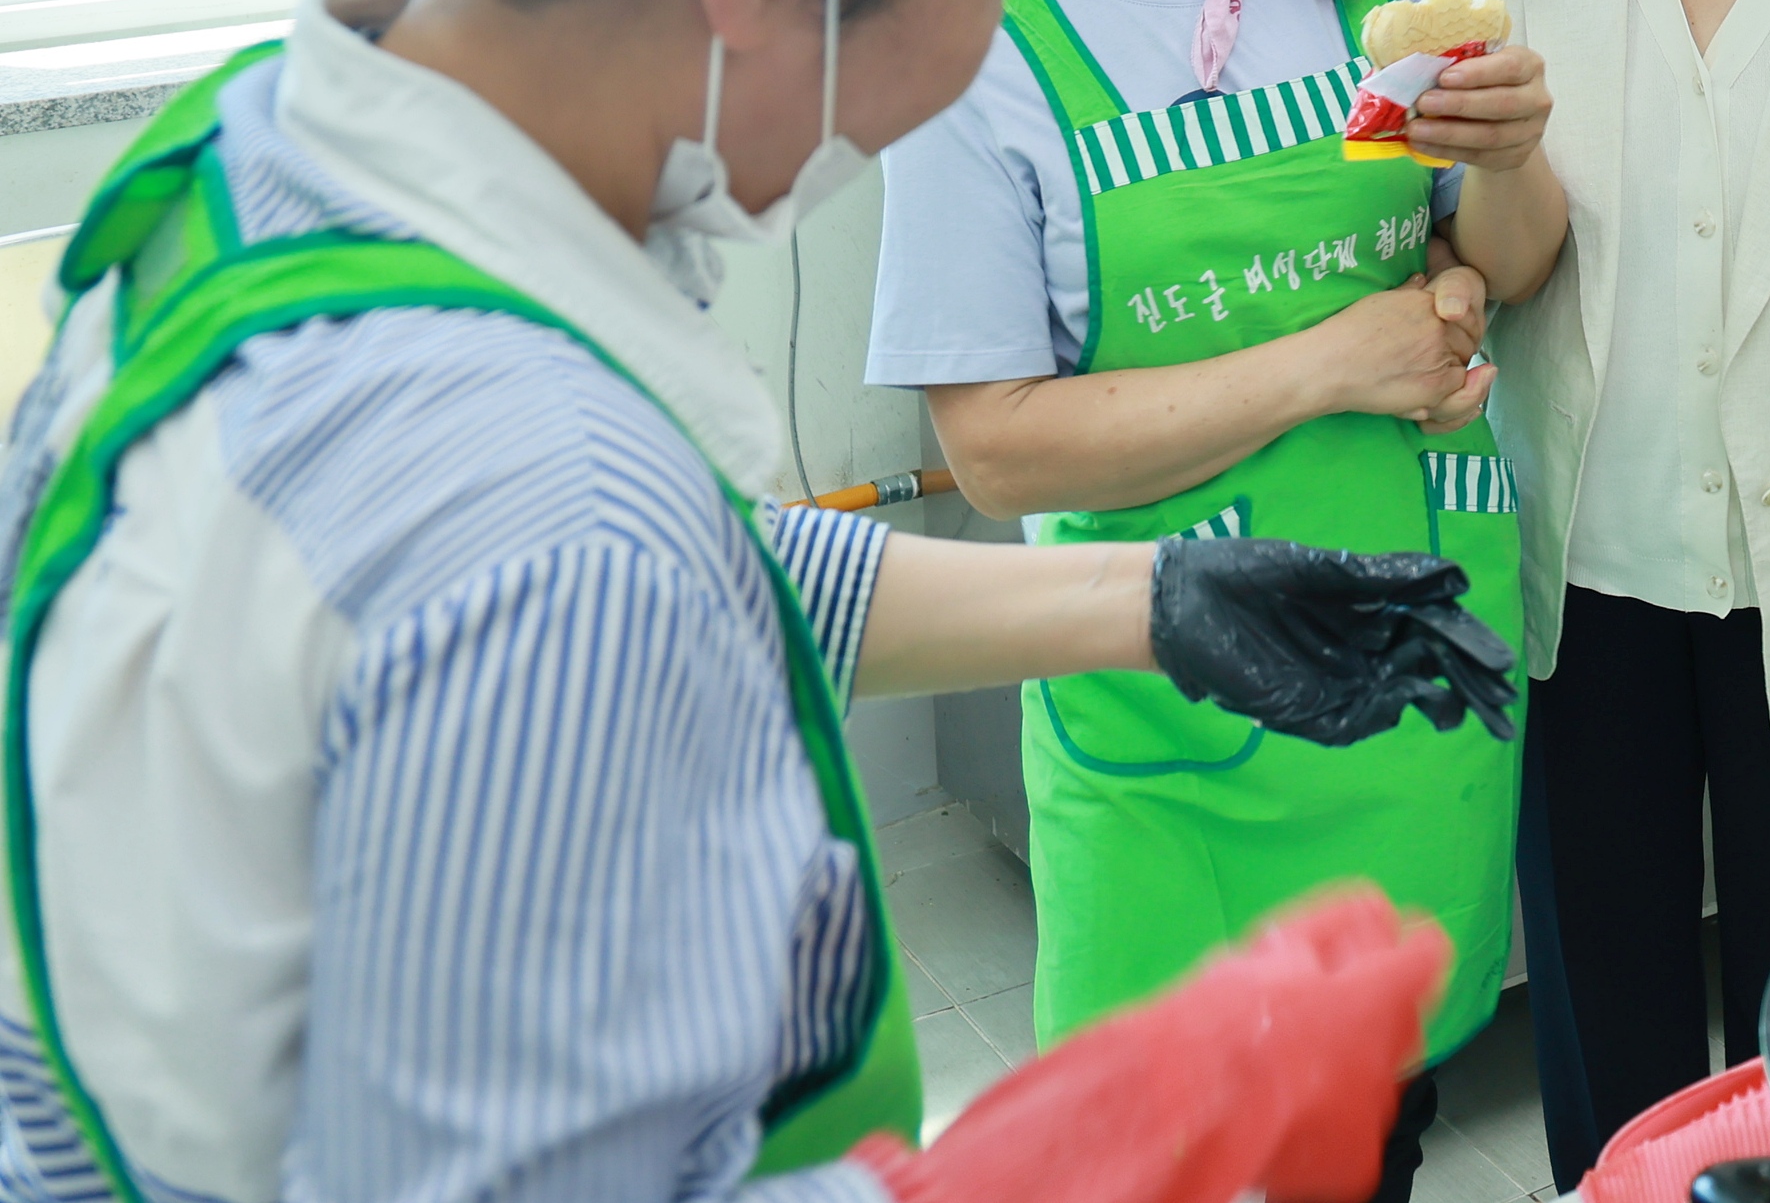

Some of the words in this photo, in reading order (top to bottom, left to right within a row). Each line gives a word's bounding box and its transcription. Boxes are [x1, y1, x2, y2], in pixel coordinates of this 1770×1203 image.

[1127, 269, 1230, 334] 진도군
[1243, 233, 1359, 294] 여성단체
[1375, 205, 1430, 261] 협의회
